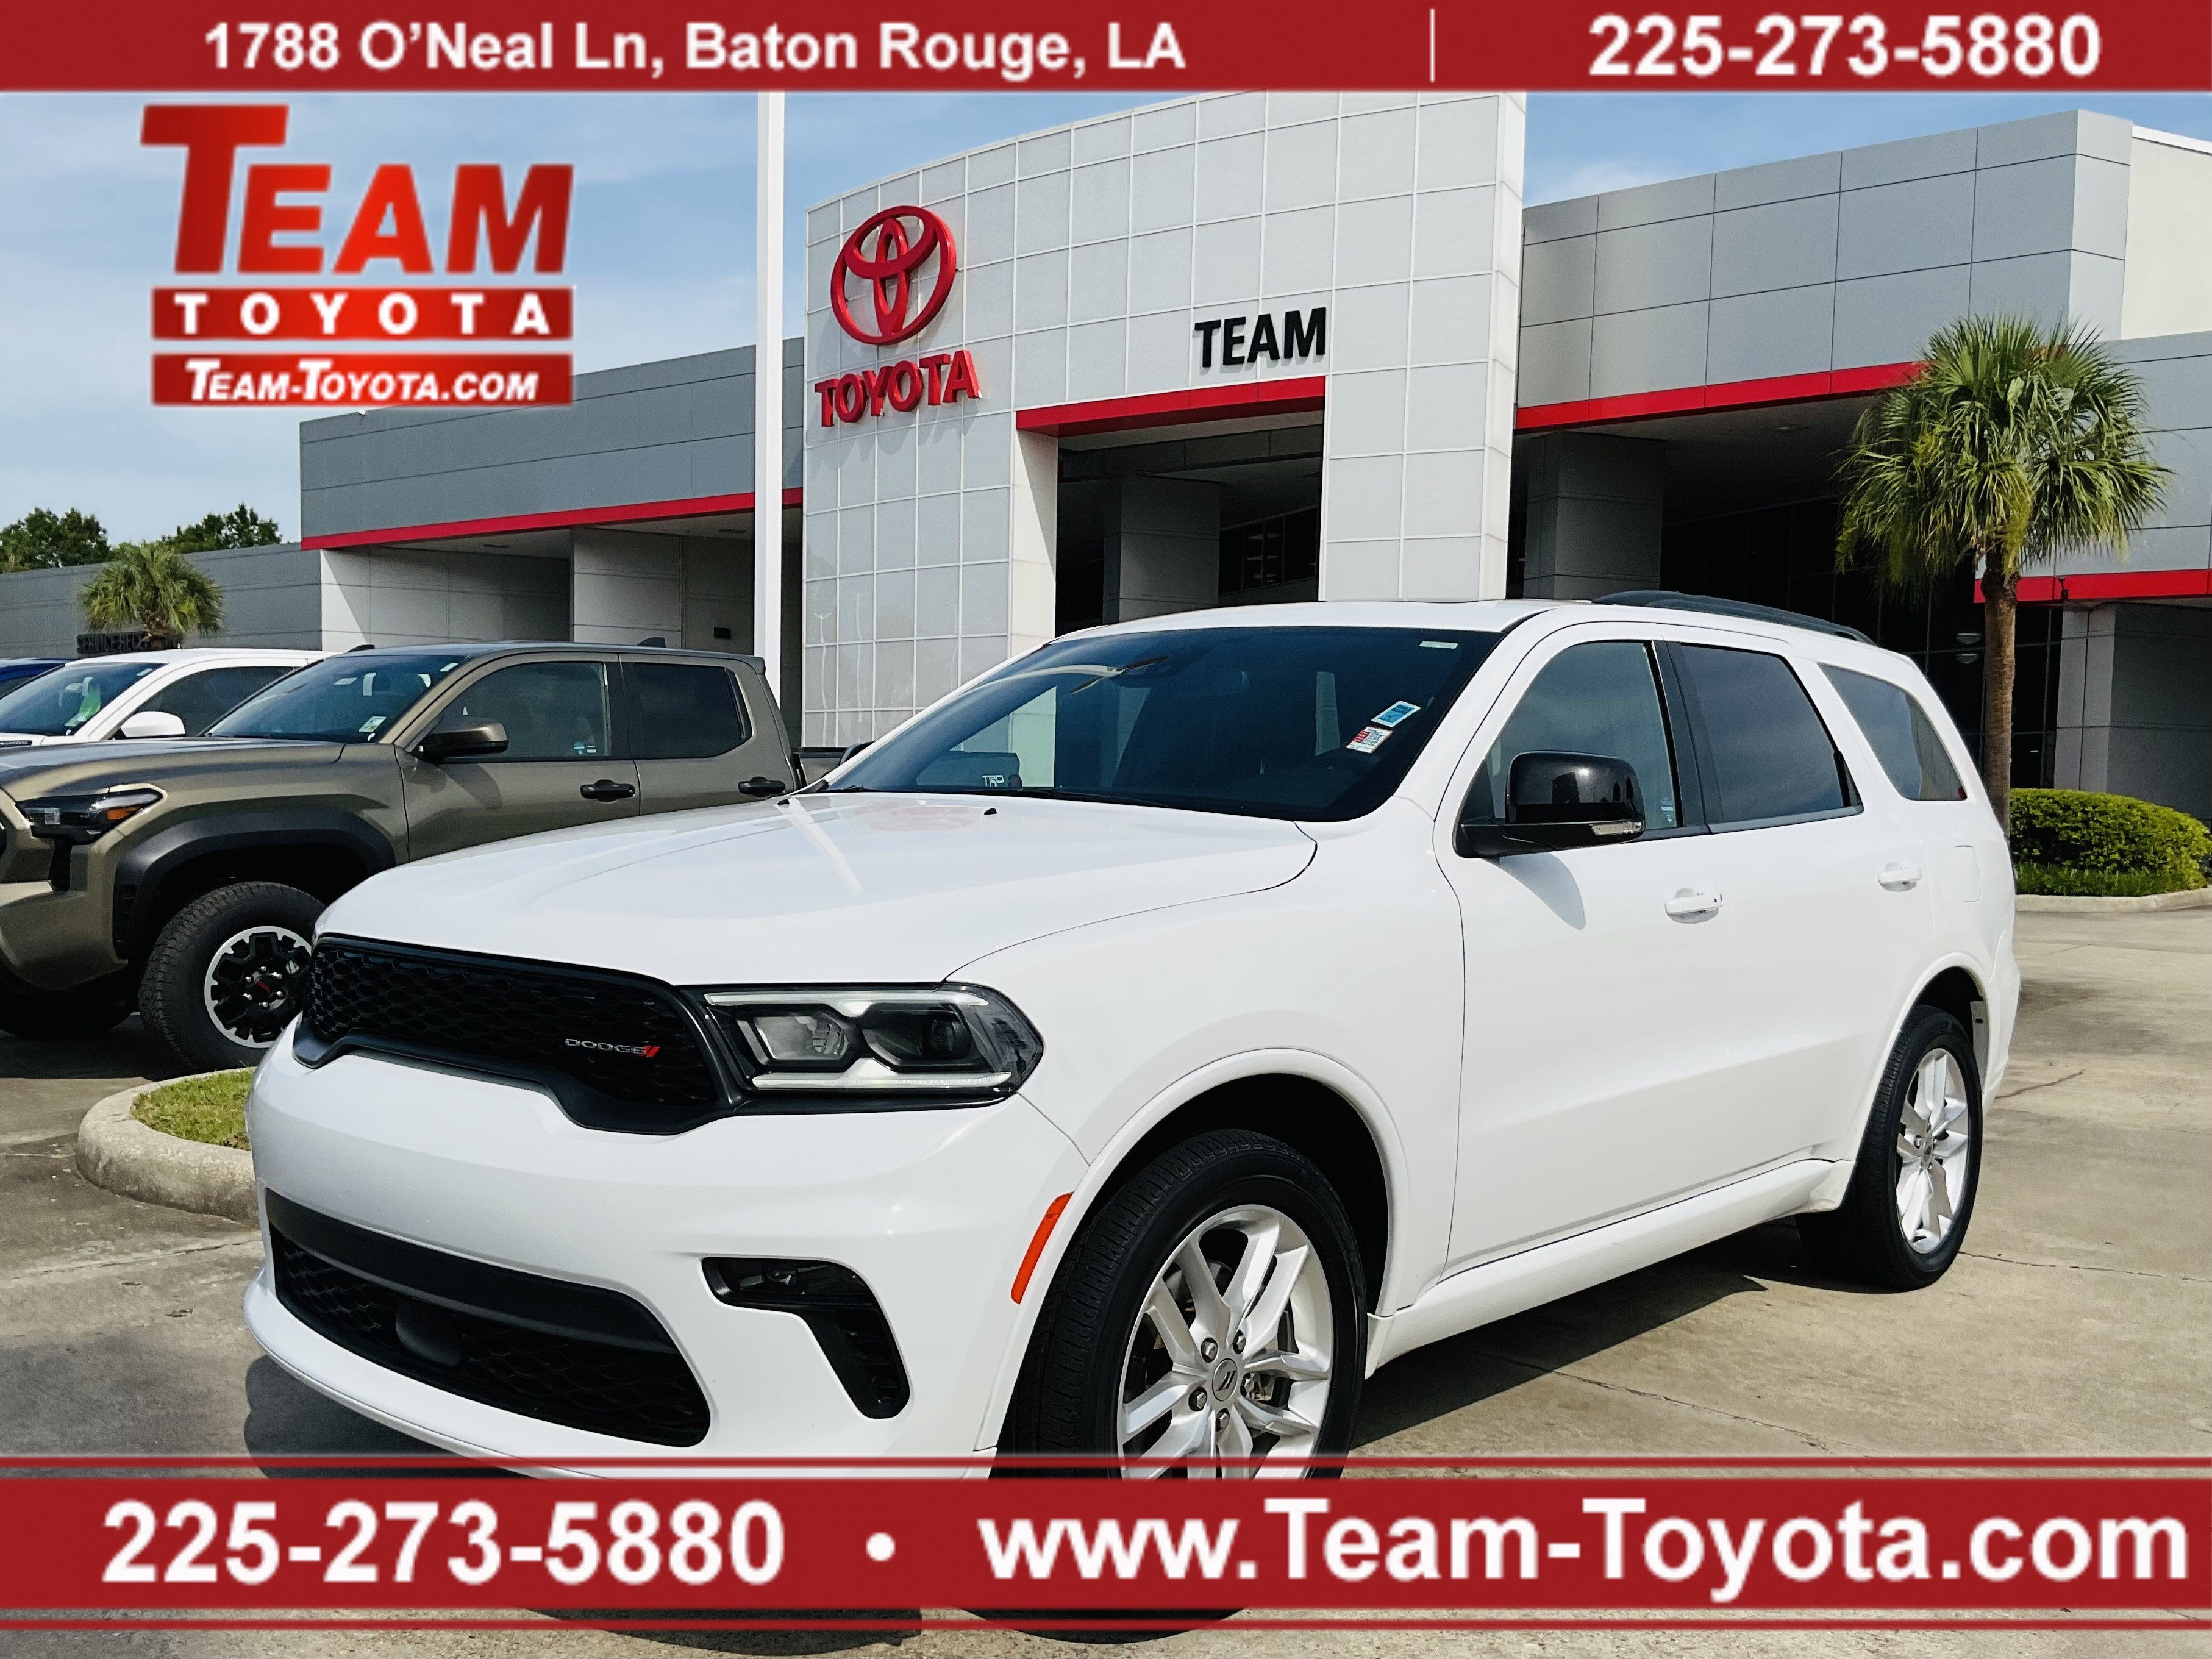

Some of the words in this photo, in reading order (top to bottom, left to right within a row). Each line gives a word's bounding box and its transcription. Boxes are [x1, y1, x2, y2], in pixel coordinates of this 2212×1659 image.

[1194, 307, 1326, 368] TEAM
[814, 349, 982, 427] TOYOTA
[982, 774, 1004, 787] TRD
[565, 1038, 648, 1055] DODGE
